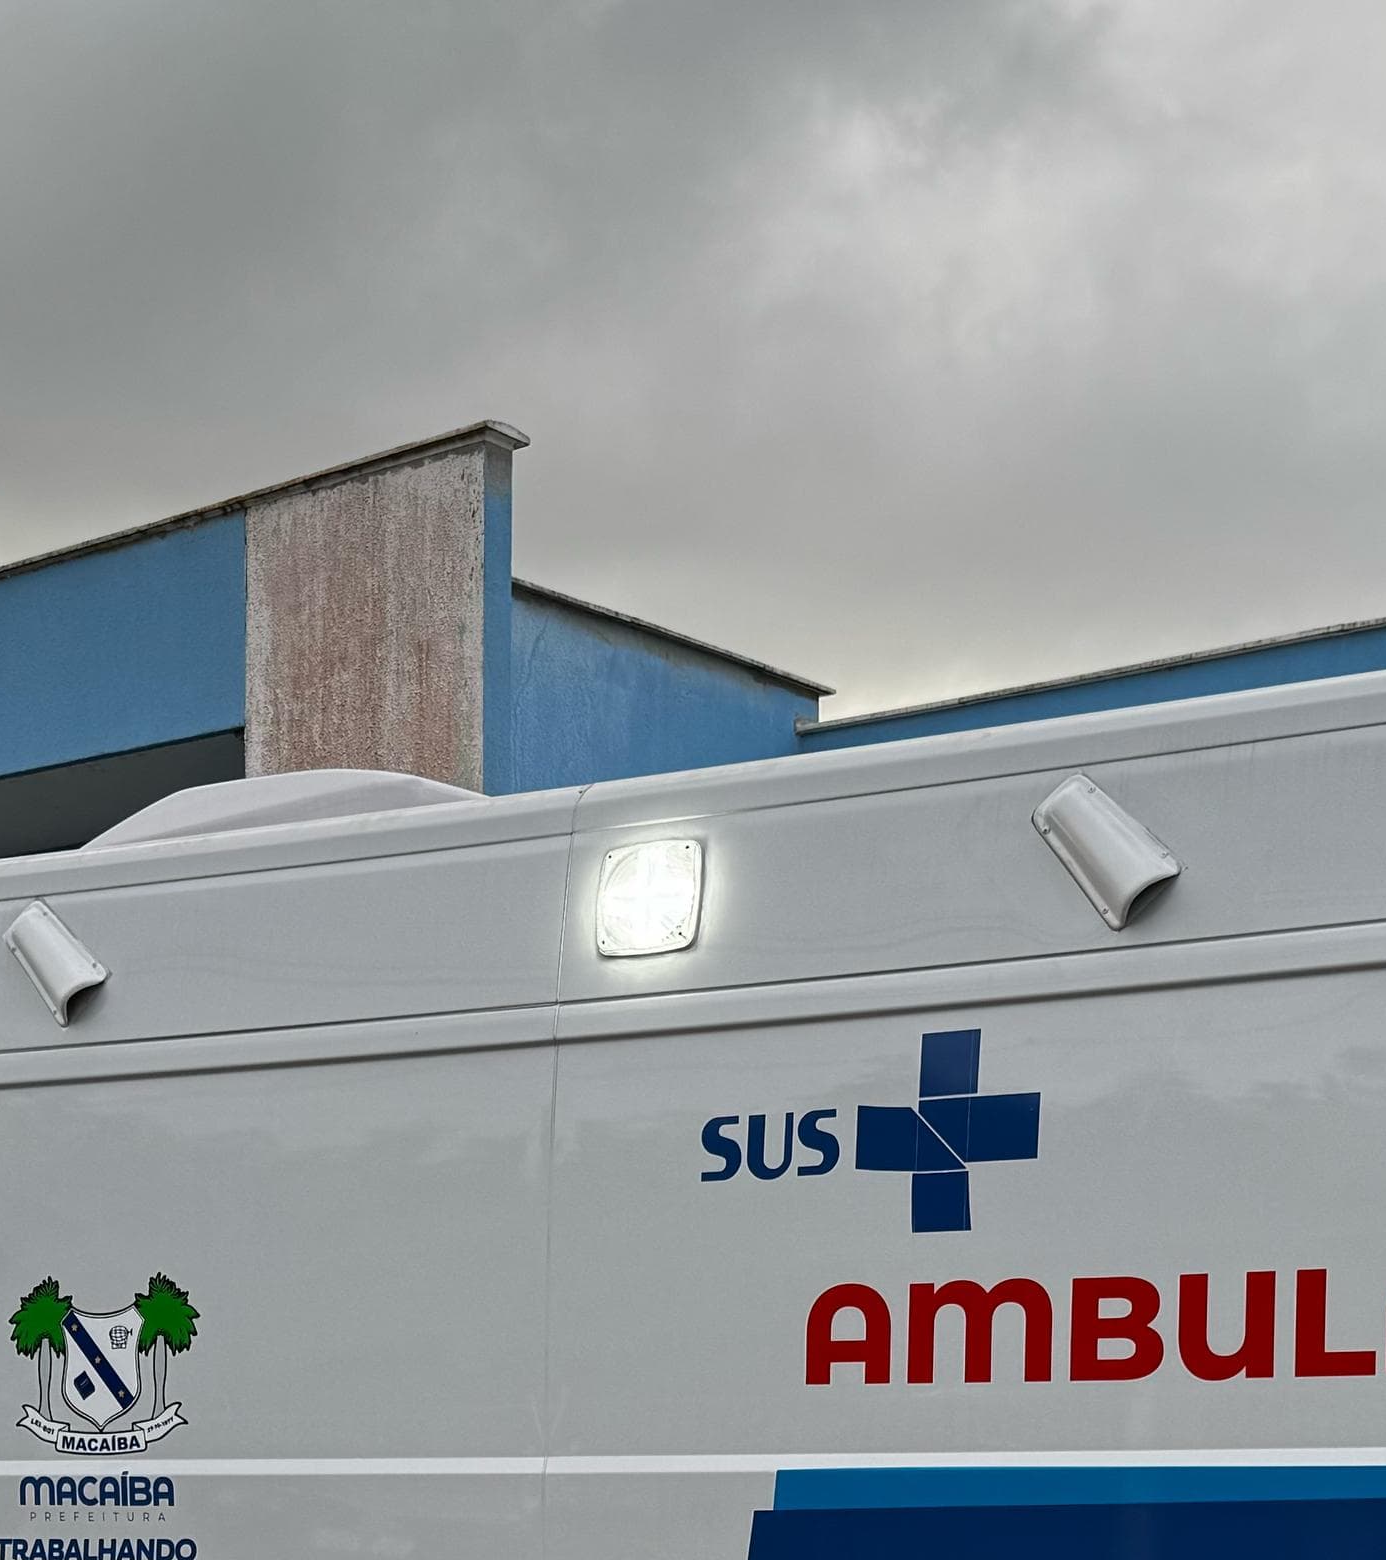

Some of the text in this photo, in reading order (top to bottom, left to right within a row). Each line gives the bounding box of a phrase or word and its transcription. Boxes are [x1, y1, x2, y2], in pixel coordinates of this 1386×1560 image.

[699, 1106, 840, 1183] SUS
[61, 1434, 141, 1451] MACAÍBA
[19, 1470, 175, 1507] MACAÍBA
[30, 1511, 166, 1522] PREFEITURA
